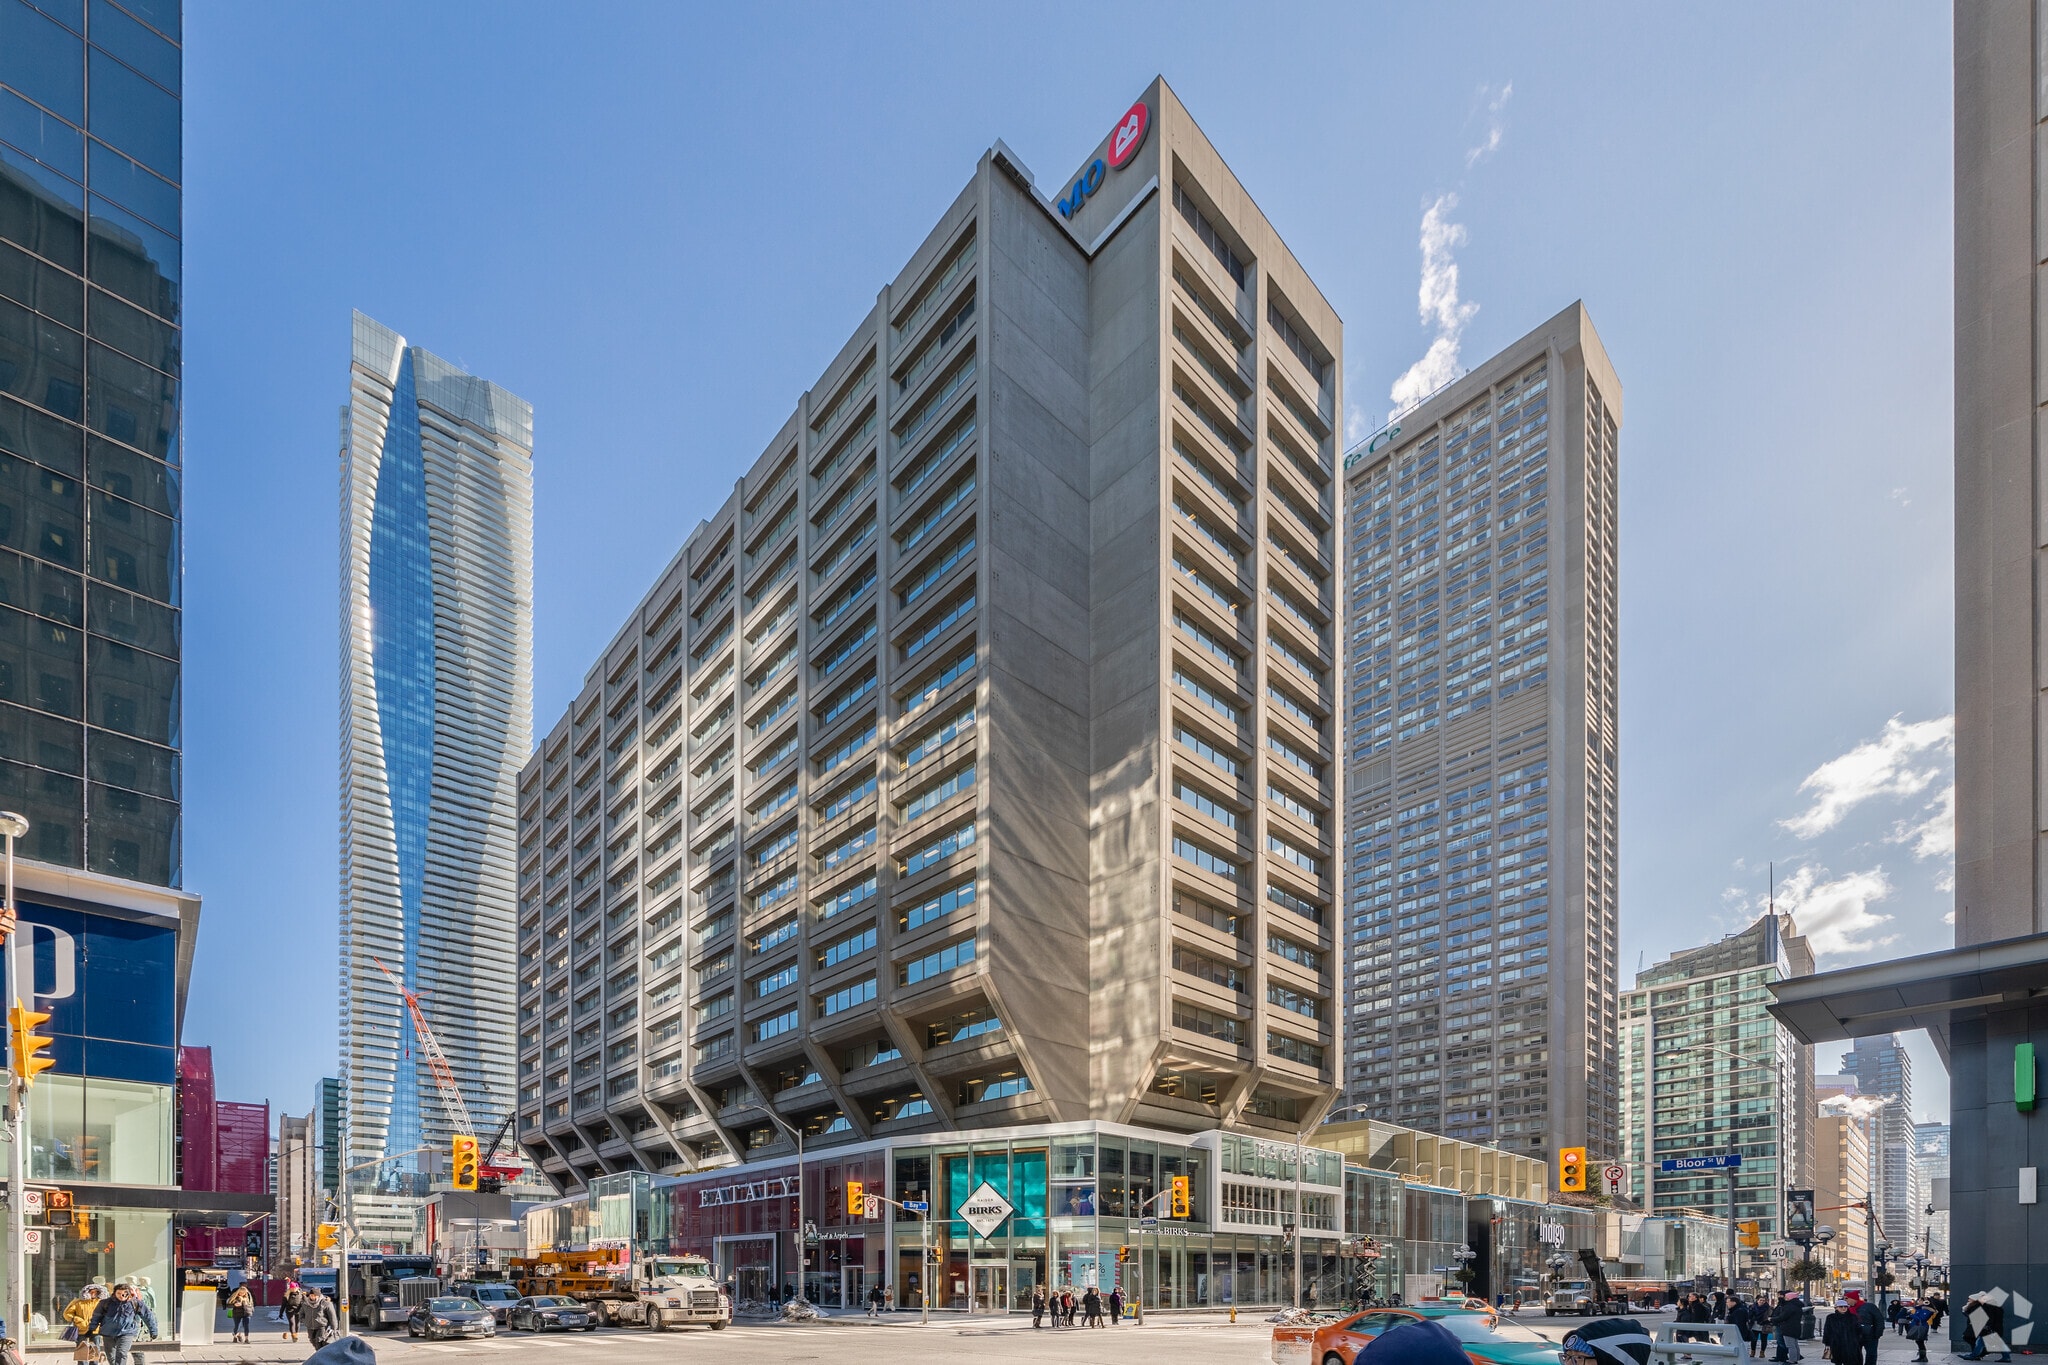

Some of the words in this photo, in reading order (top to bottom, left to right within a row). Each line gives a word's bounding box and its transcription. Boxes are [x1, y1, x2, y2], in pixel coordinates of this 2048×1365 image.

[1676, 1160, 1706, 1169] Bloor
[1716, 1157, 1726, 1165] W
[701, 1177, 792, 1207] EATALY
[968, 1206, 1002, 1215] BIRKS
[1164, 1227, 1188, 1236] BIRKS
[1771, 1247, 1785, 1258] 40
